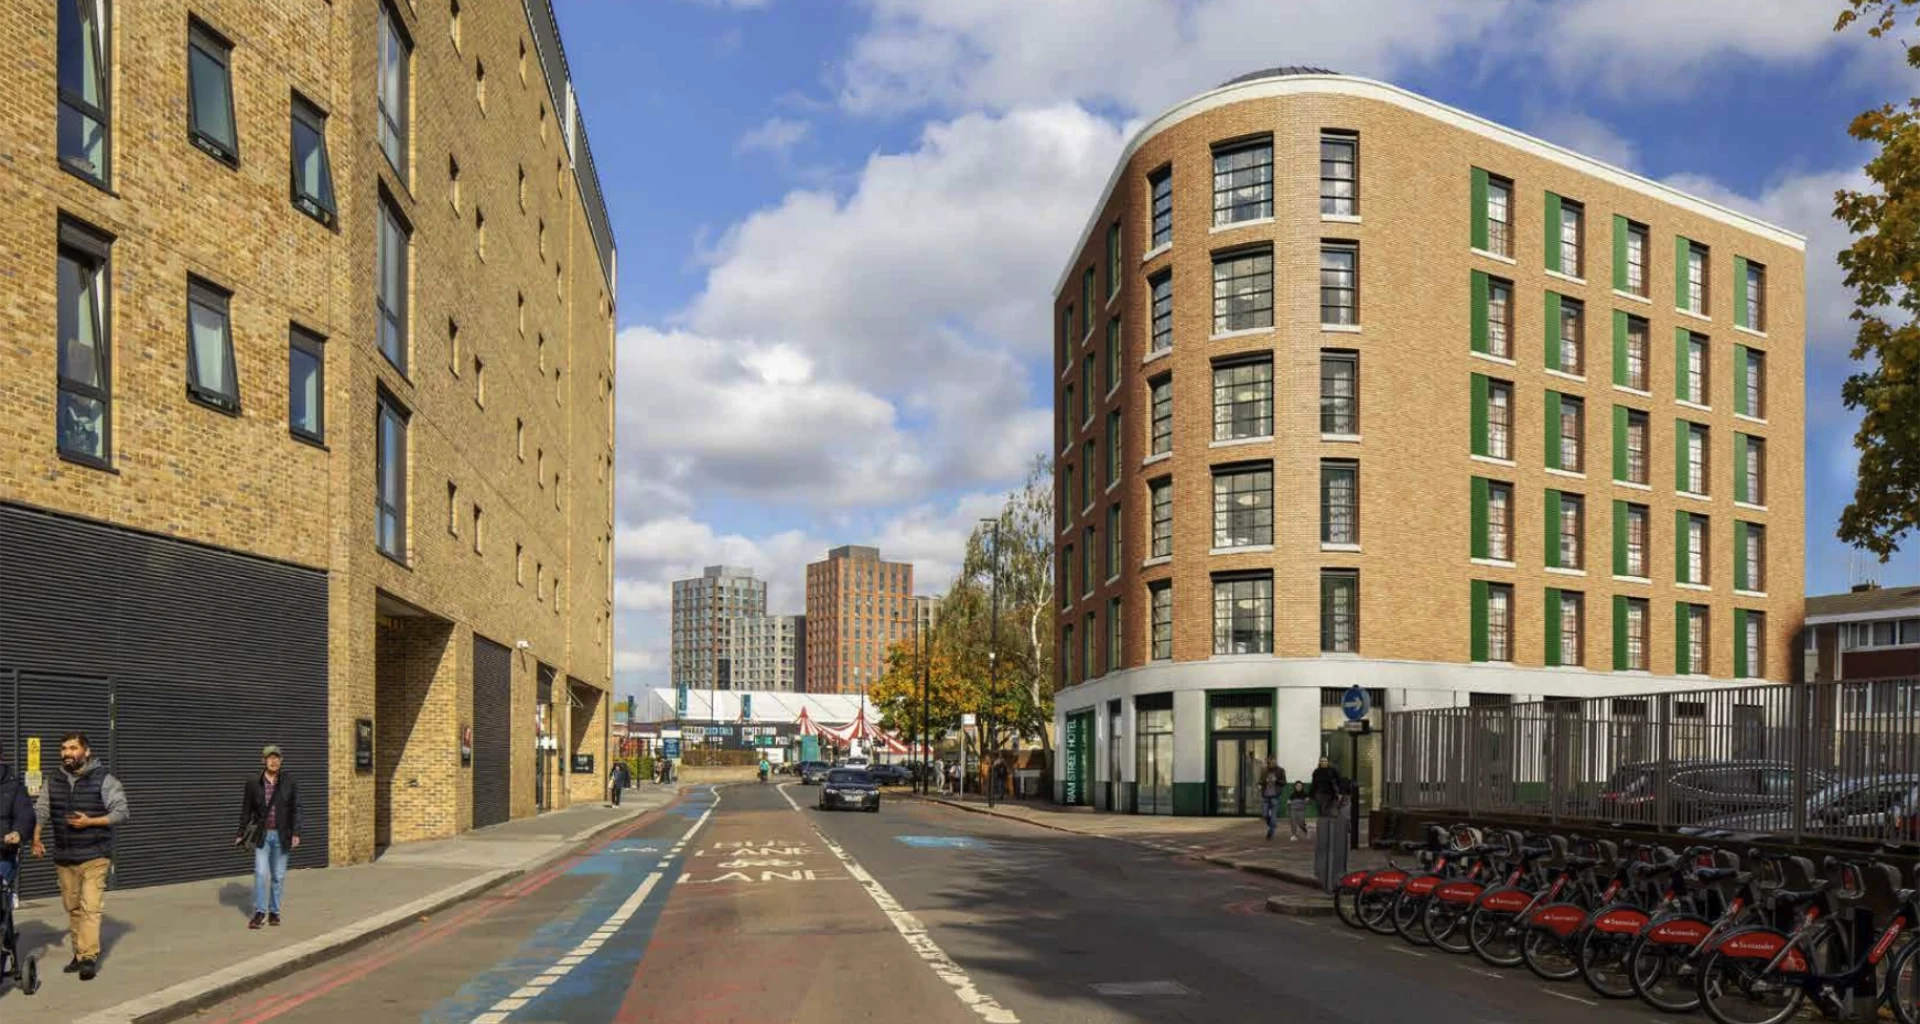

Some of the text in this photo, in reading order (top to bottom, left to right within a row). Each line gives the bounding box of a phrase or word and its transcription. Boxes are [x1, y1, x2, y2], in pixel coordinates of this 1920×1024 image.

[1067, 719, 1076, 803] RAM STREET HOTEL
[676, 869, 849, 884] LANE
[1610, 918, 1640, 927] Santander
[1666, 928, 1699, 937] Santander
[1739, 941, 1776, 950] Santander
